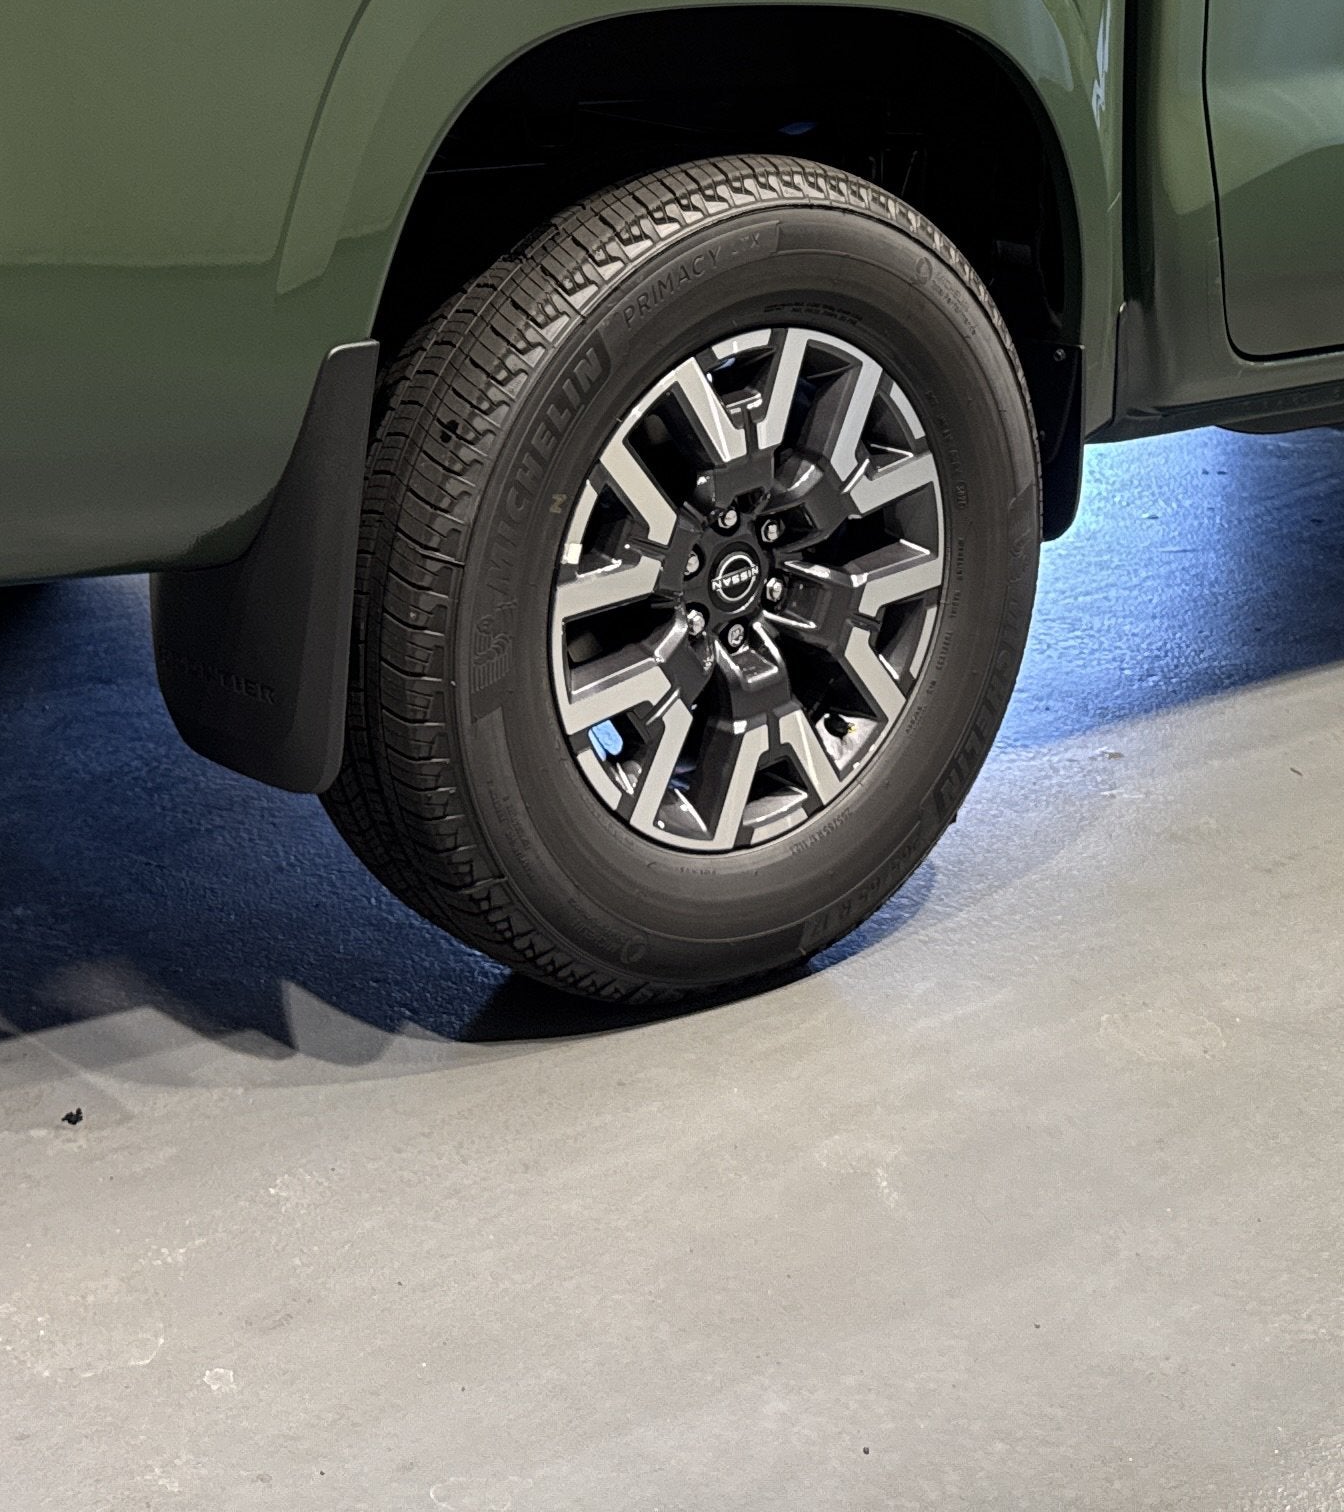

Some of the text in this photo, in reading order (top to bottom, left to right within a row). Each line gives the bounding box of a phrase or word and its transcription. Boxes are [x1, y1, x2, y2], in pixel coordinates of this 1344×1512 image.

[621, 244, 723, 330] PRIMACY
[485, 345, 606, 584] MICHELIN
[711, 565, 759, 591] NISSAN
